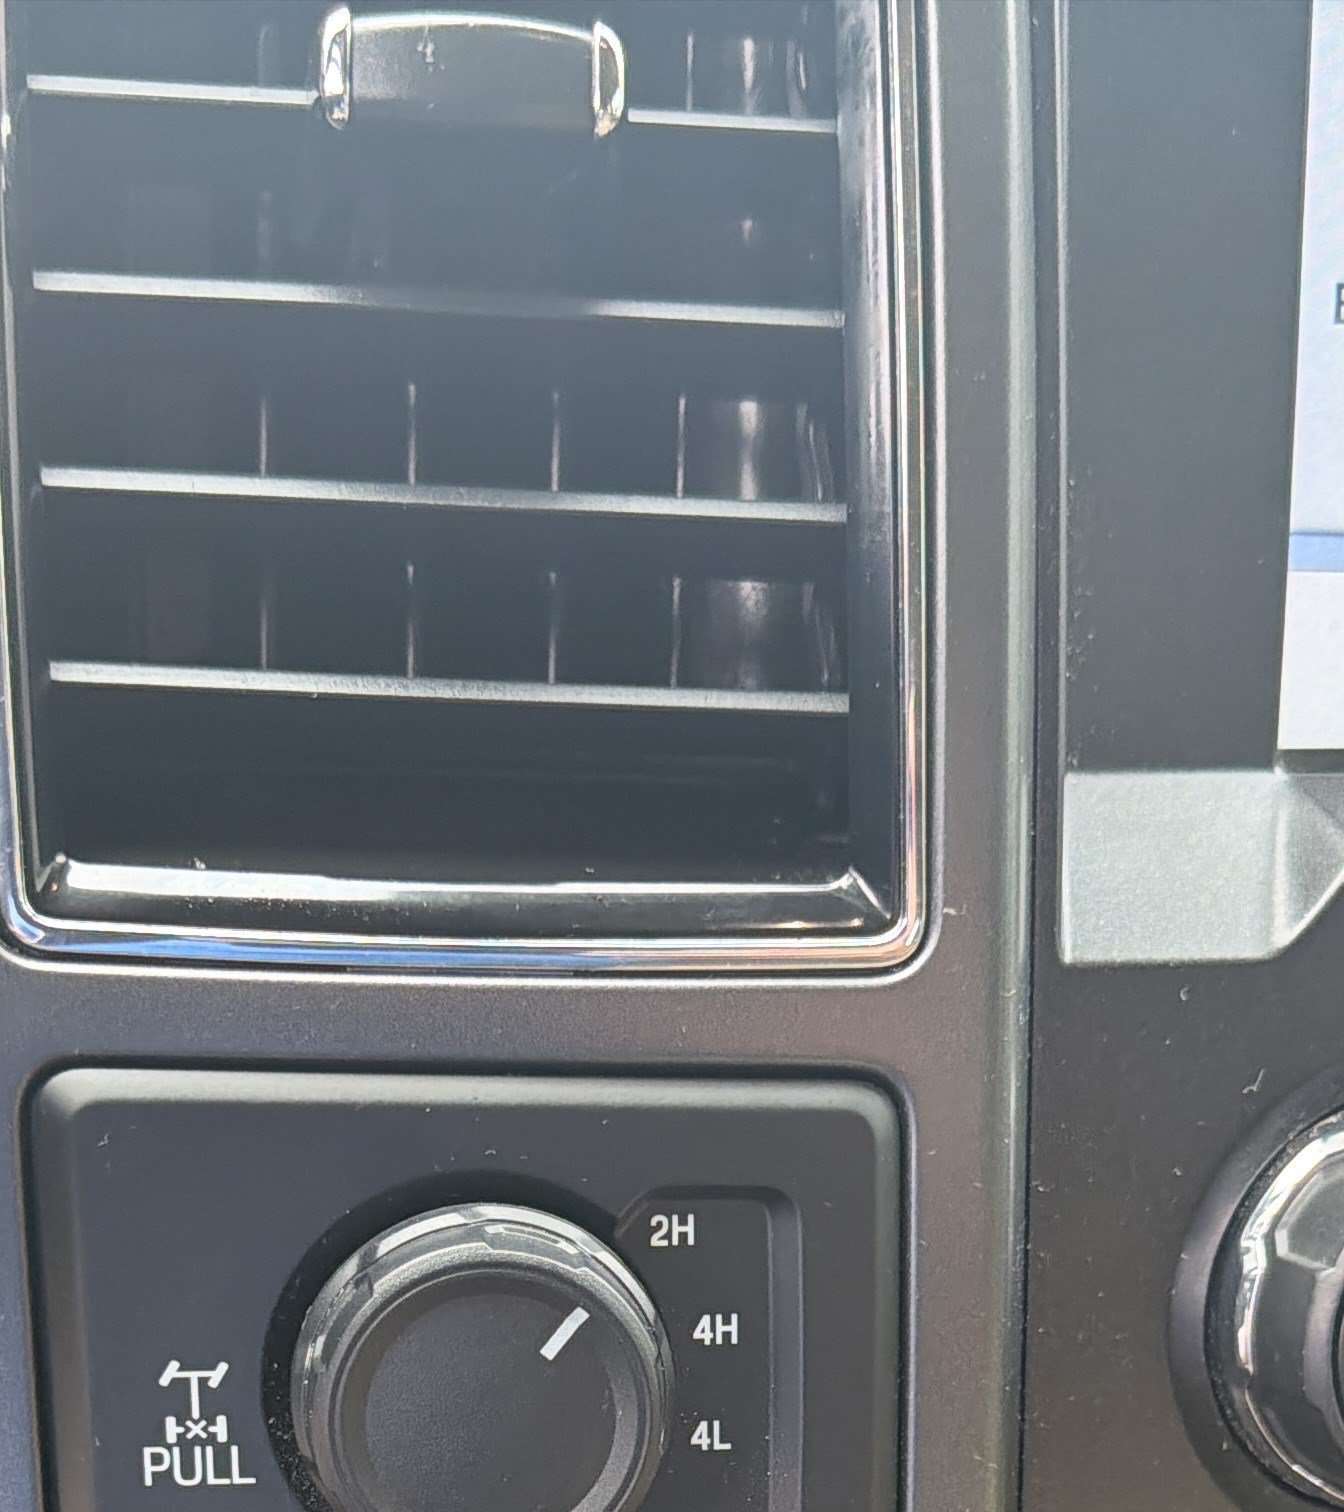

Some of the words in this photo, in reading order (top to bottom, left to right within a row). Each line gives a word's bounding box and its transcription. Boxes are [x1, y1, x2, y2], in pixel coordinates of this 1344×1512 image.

[650, 1214, 695, 1247] 2H
[692, 1313, 738, 1346] 4H
[690, 1421, 732, 1452] 4L
[142, 1445, 256, 1487] PULL
